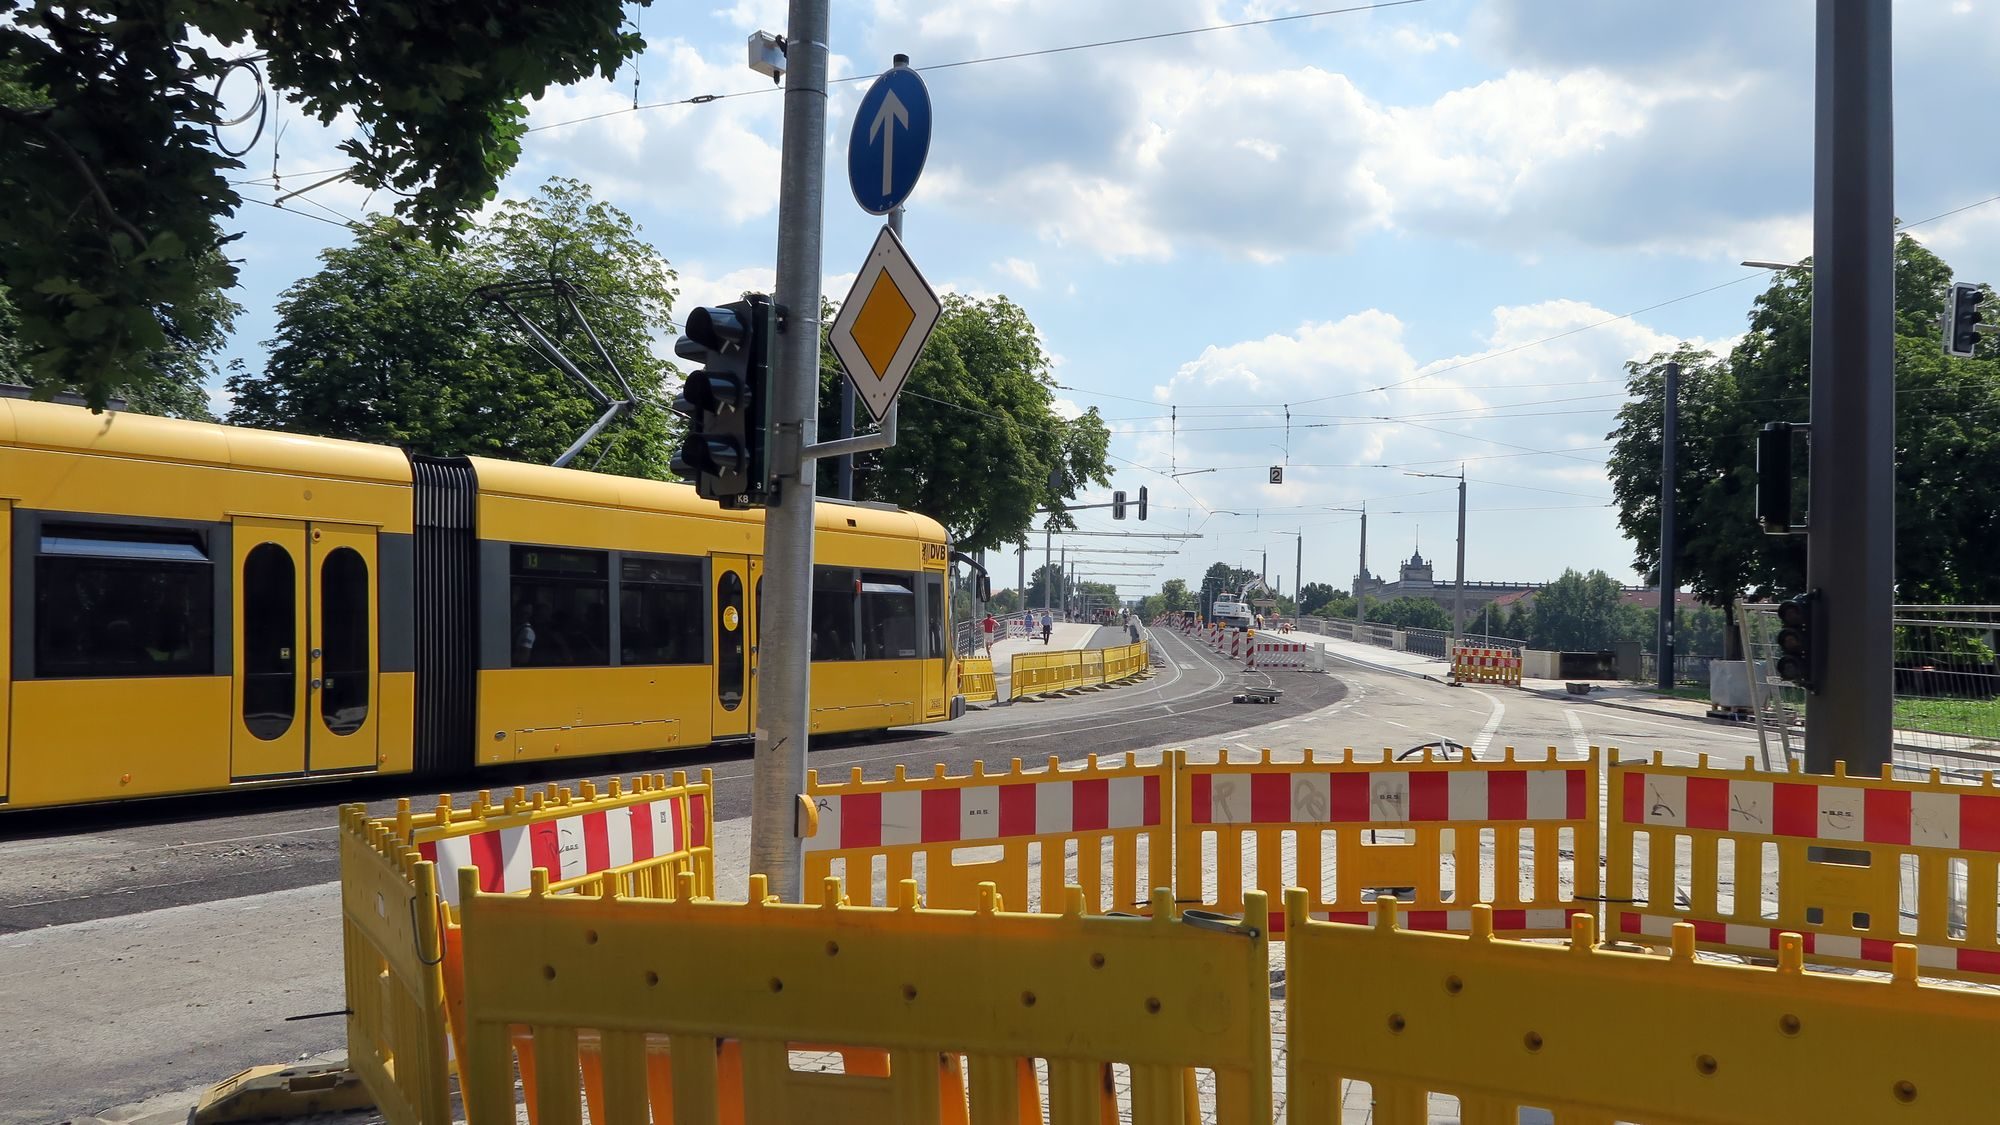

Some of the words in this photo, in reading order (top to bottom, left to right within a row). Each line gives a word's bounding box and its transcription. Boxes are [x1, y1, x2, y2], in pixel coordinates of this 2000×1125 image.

[1272, 470, 1280, 481] 2
[737, 494, 749, 504] K8
[930, 544, 946, 560] DVB
[527, 553, 538, 567] 13
